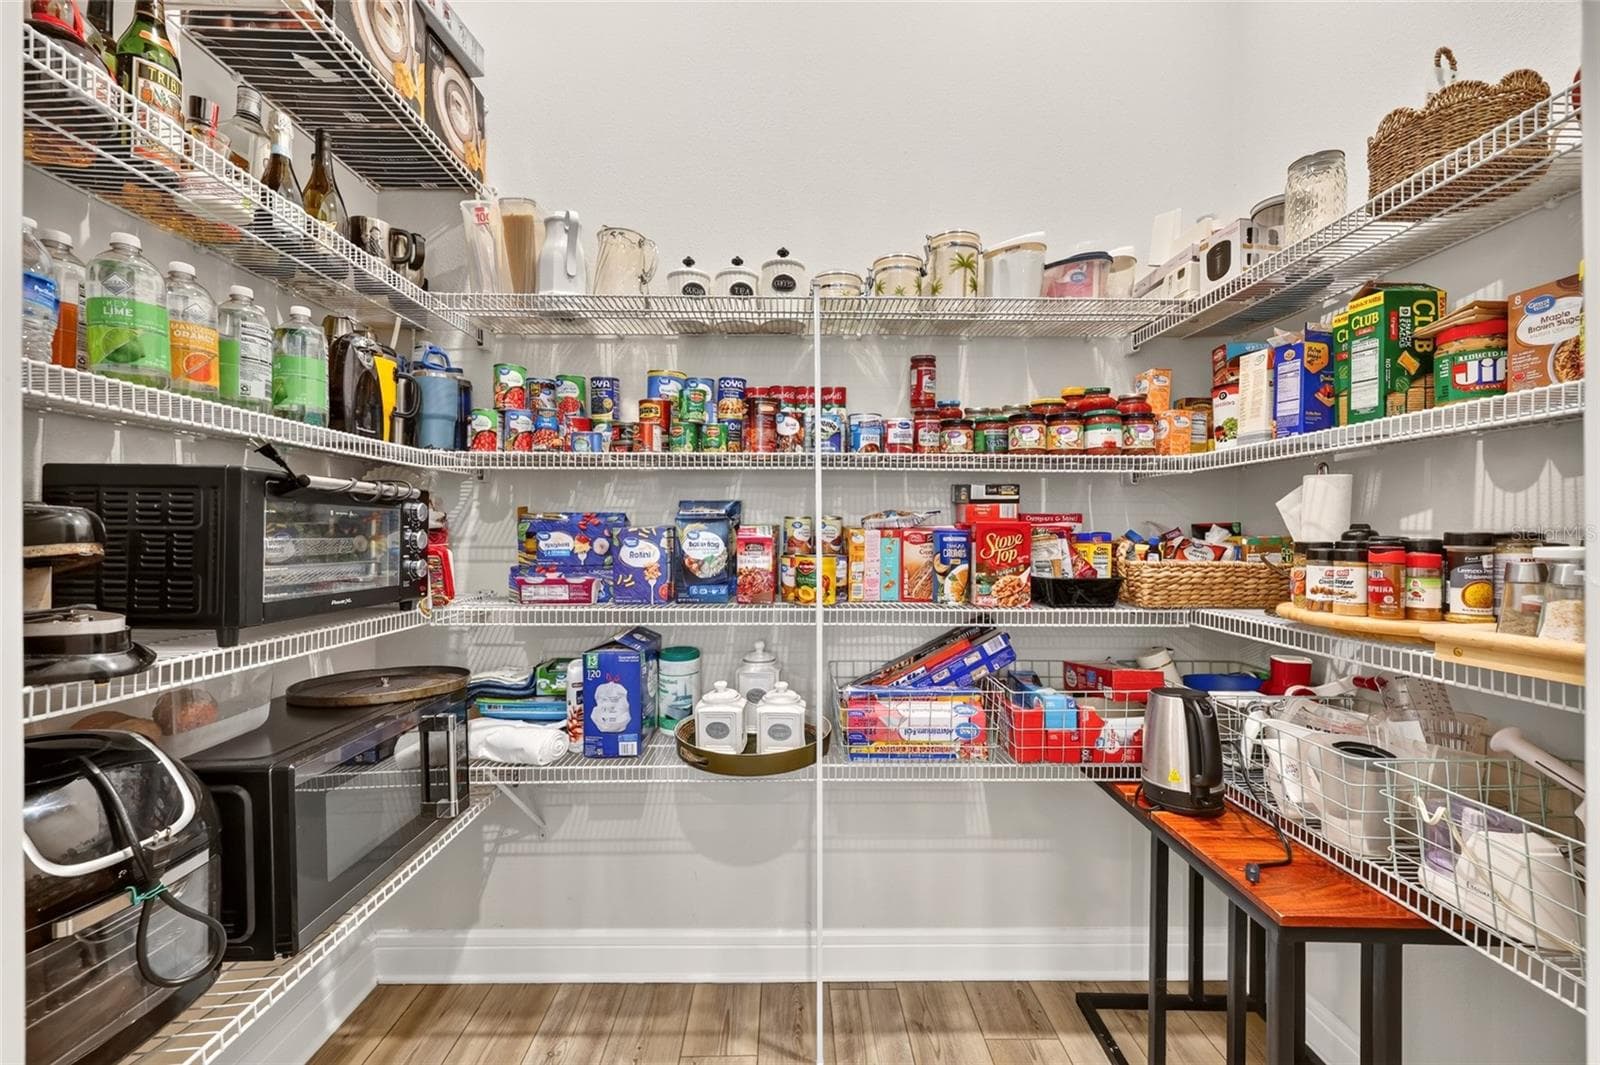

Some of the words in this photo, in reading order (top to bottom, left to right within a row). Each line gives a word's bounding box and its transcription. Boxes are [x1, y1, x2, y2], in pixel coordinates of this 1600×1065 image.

[734, 287, 751, 295] TEA
[1515, 295, 1522, 305] 8
[103, 305, 134, 317] LIME
[1540, 310, 1571, 324] Maple
[1351, 311, 1380, 331] CLUB
[1413, 299, 1436, 352] CLB
[1528, 322, 1555, 334] Brown
[1454, 356, 1508, 385] Jif
[980, 532, 1023, 559] Stove
[995, 549, 1018, 565] Top
